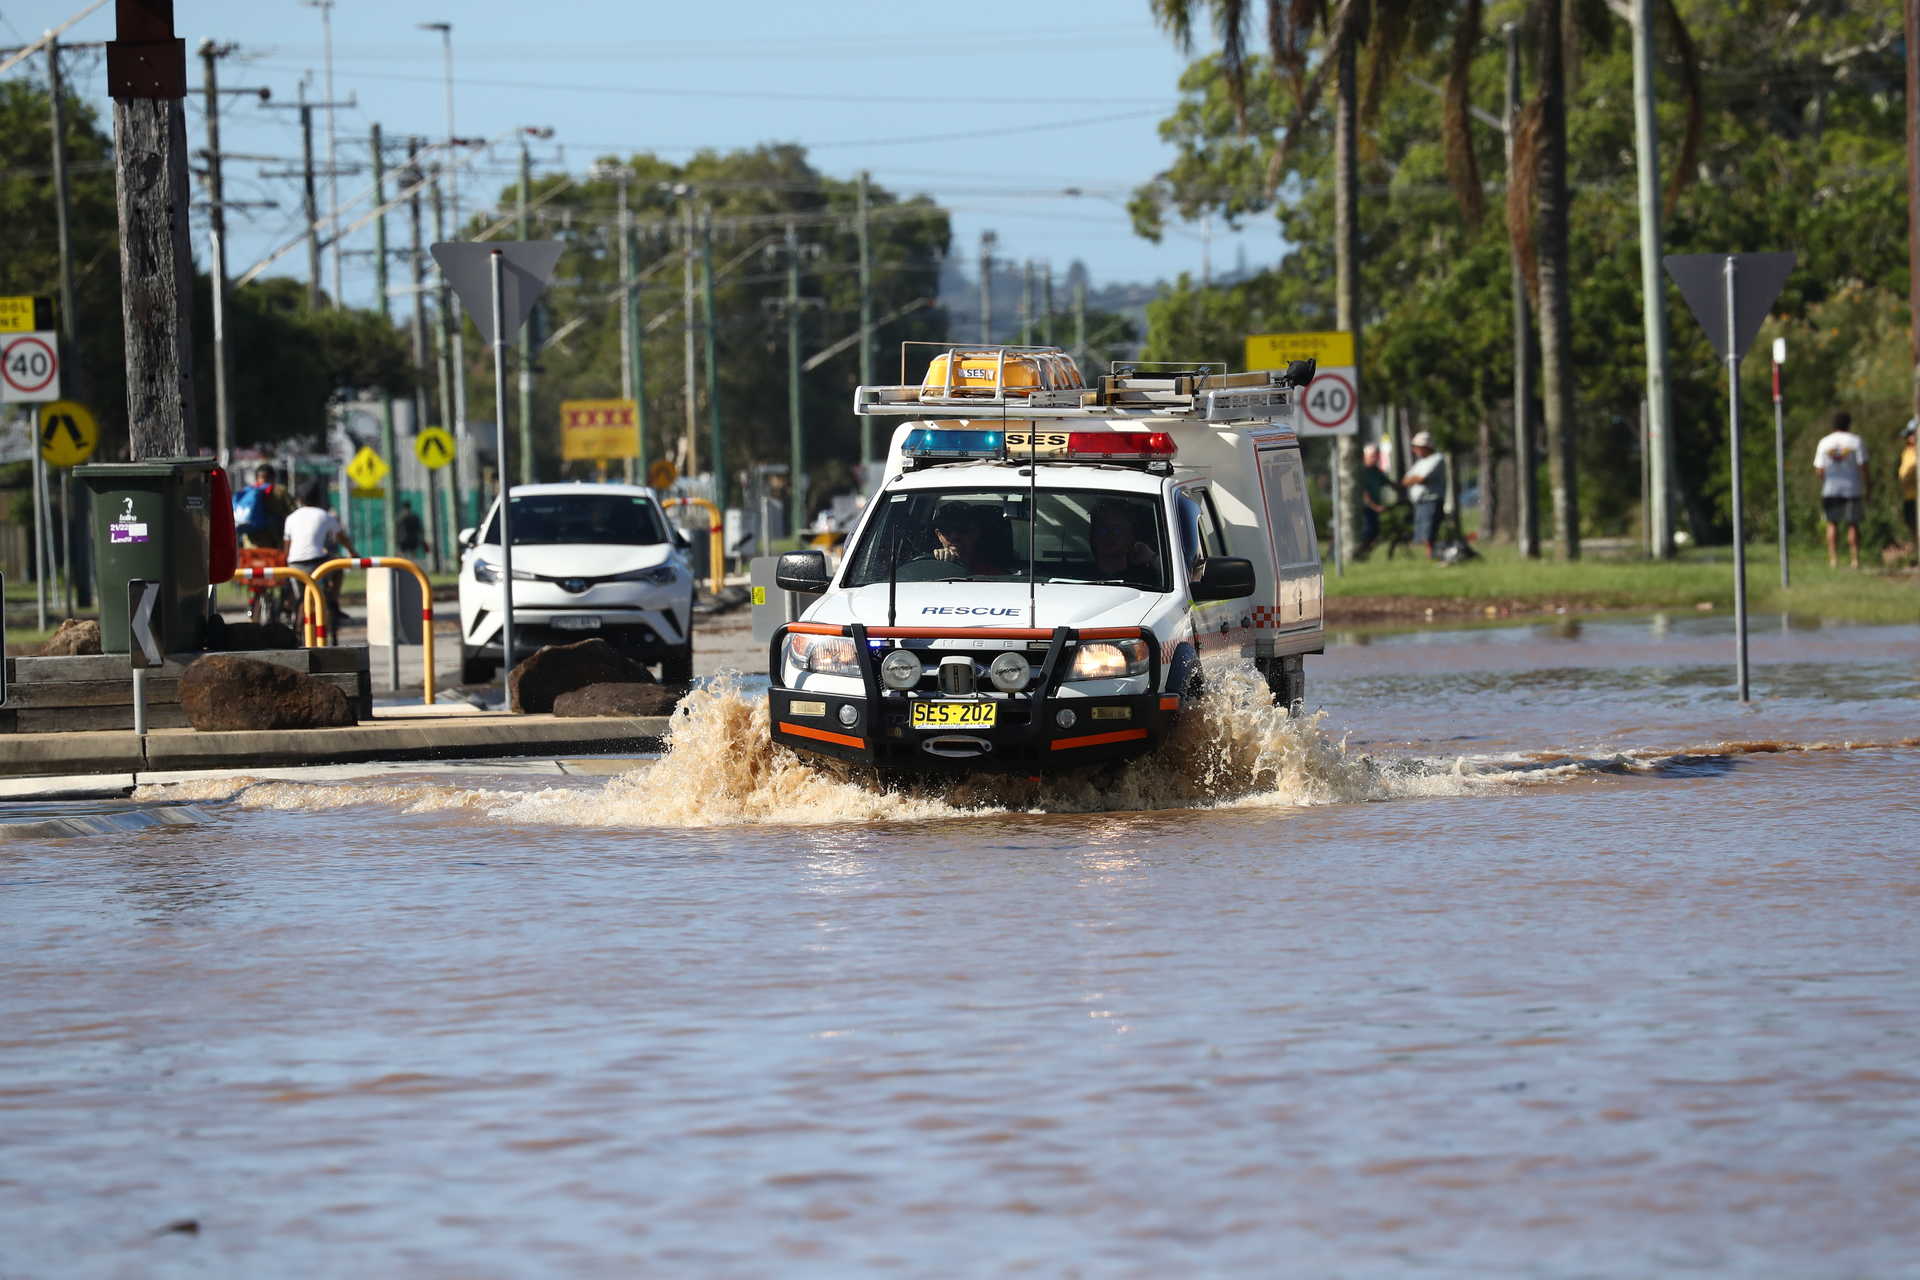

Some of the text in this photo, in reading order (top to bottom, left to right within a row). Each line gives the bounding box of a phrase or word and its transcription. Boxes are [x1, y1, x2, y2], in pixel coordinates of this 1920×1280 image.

[1269, 337, 1328, 350] SCHOOL
[12, 352, 47, 377] 40
[966, 368, 985, 377] SES
[1311, 388, 1347, 413] 40
[1006, 434, 1066, 445] SES
[921, 606, 1022, 617] RESCUE
